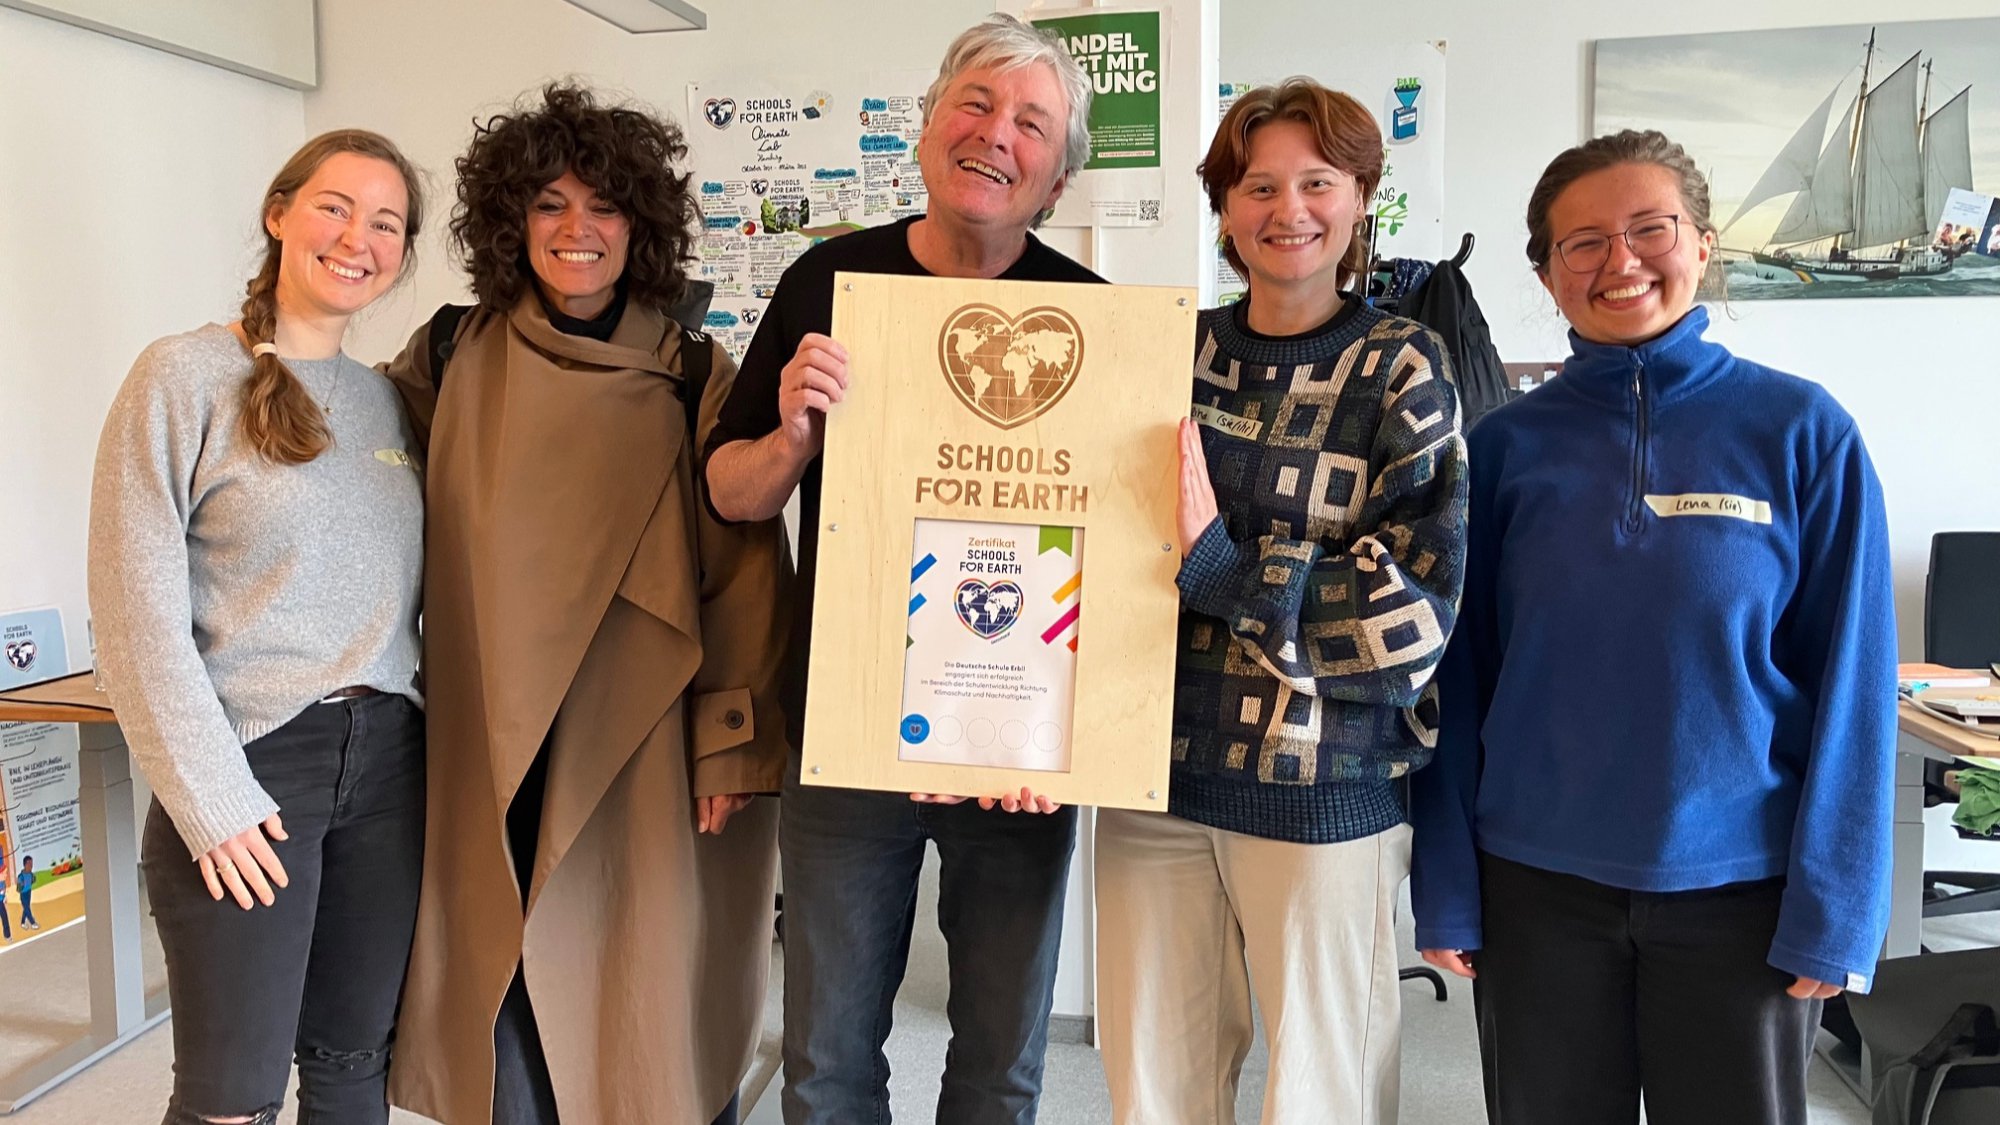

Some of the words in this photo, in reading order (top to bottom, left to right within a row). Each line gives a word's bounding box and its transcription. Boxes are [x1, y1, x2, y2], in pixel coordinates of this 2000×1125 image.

[1057, 32, 1139, 55] ANDEL
[1106, 52, 1149, 71] MIT
[746, 98, 792, 111] SCHOOLS
[739, 112, 762, 124] FOR
[765, 111, 798, 123] EARTH
[751, 125, 791, 141] Climate
[757, 139, 782, 152] Lab
[770, 186, 784, 194] FOR
[937, 443, 1071, 476] SCHOOLS
[915, 477, 982, 507] FOR
[993, 481, 1088, 512] EARTH
[1676, 499, 1712, 511] Lena
[968, 537, 1016, 549] Zertifikat
[967, 549, 1016, 562] SCHOOLS
[959, 561, 984, 573] FOR
[987, 563, 1022, 575] EARTH
[944, 661, 955, 669] Die
[955, 662, 987, 670] Deutsche
[987, 664, 1010, 672] Schule
[945, 672, 975, 680] engagiert
[989, 673, 1024, 682] erfolgreich
[929, 679, 953, 687] Bereich
[965, 681, 1019, 692] Schulentwicklung
[1020, 685, 1048, 693] Richtung
[934, 689, 971, 698] Klimaschutz
